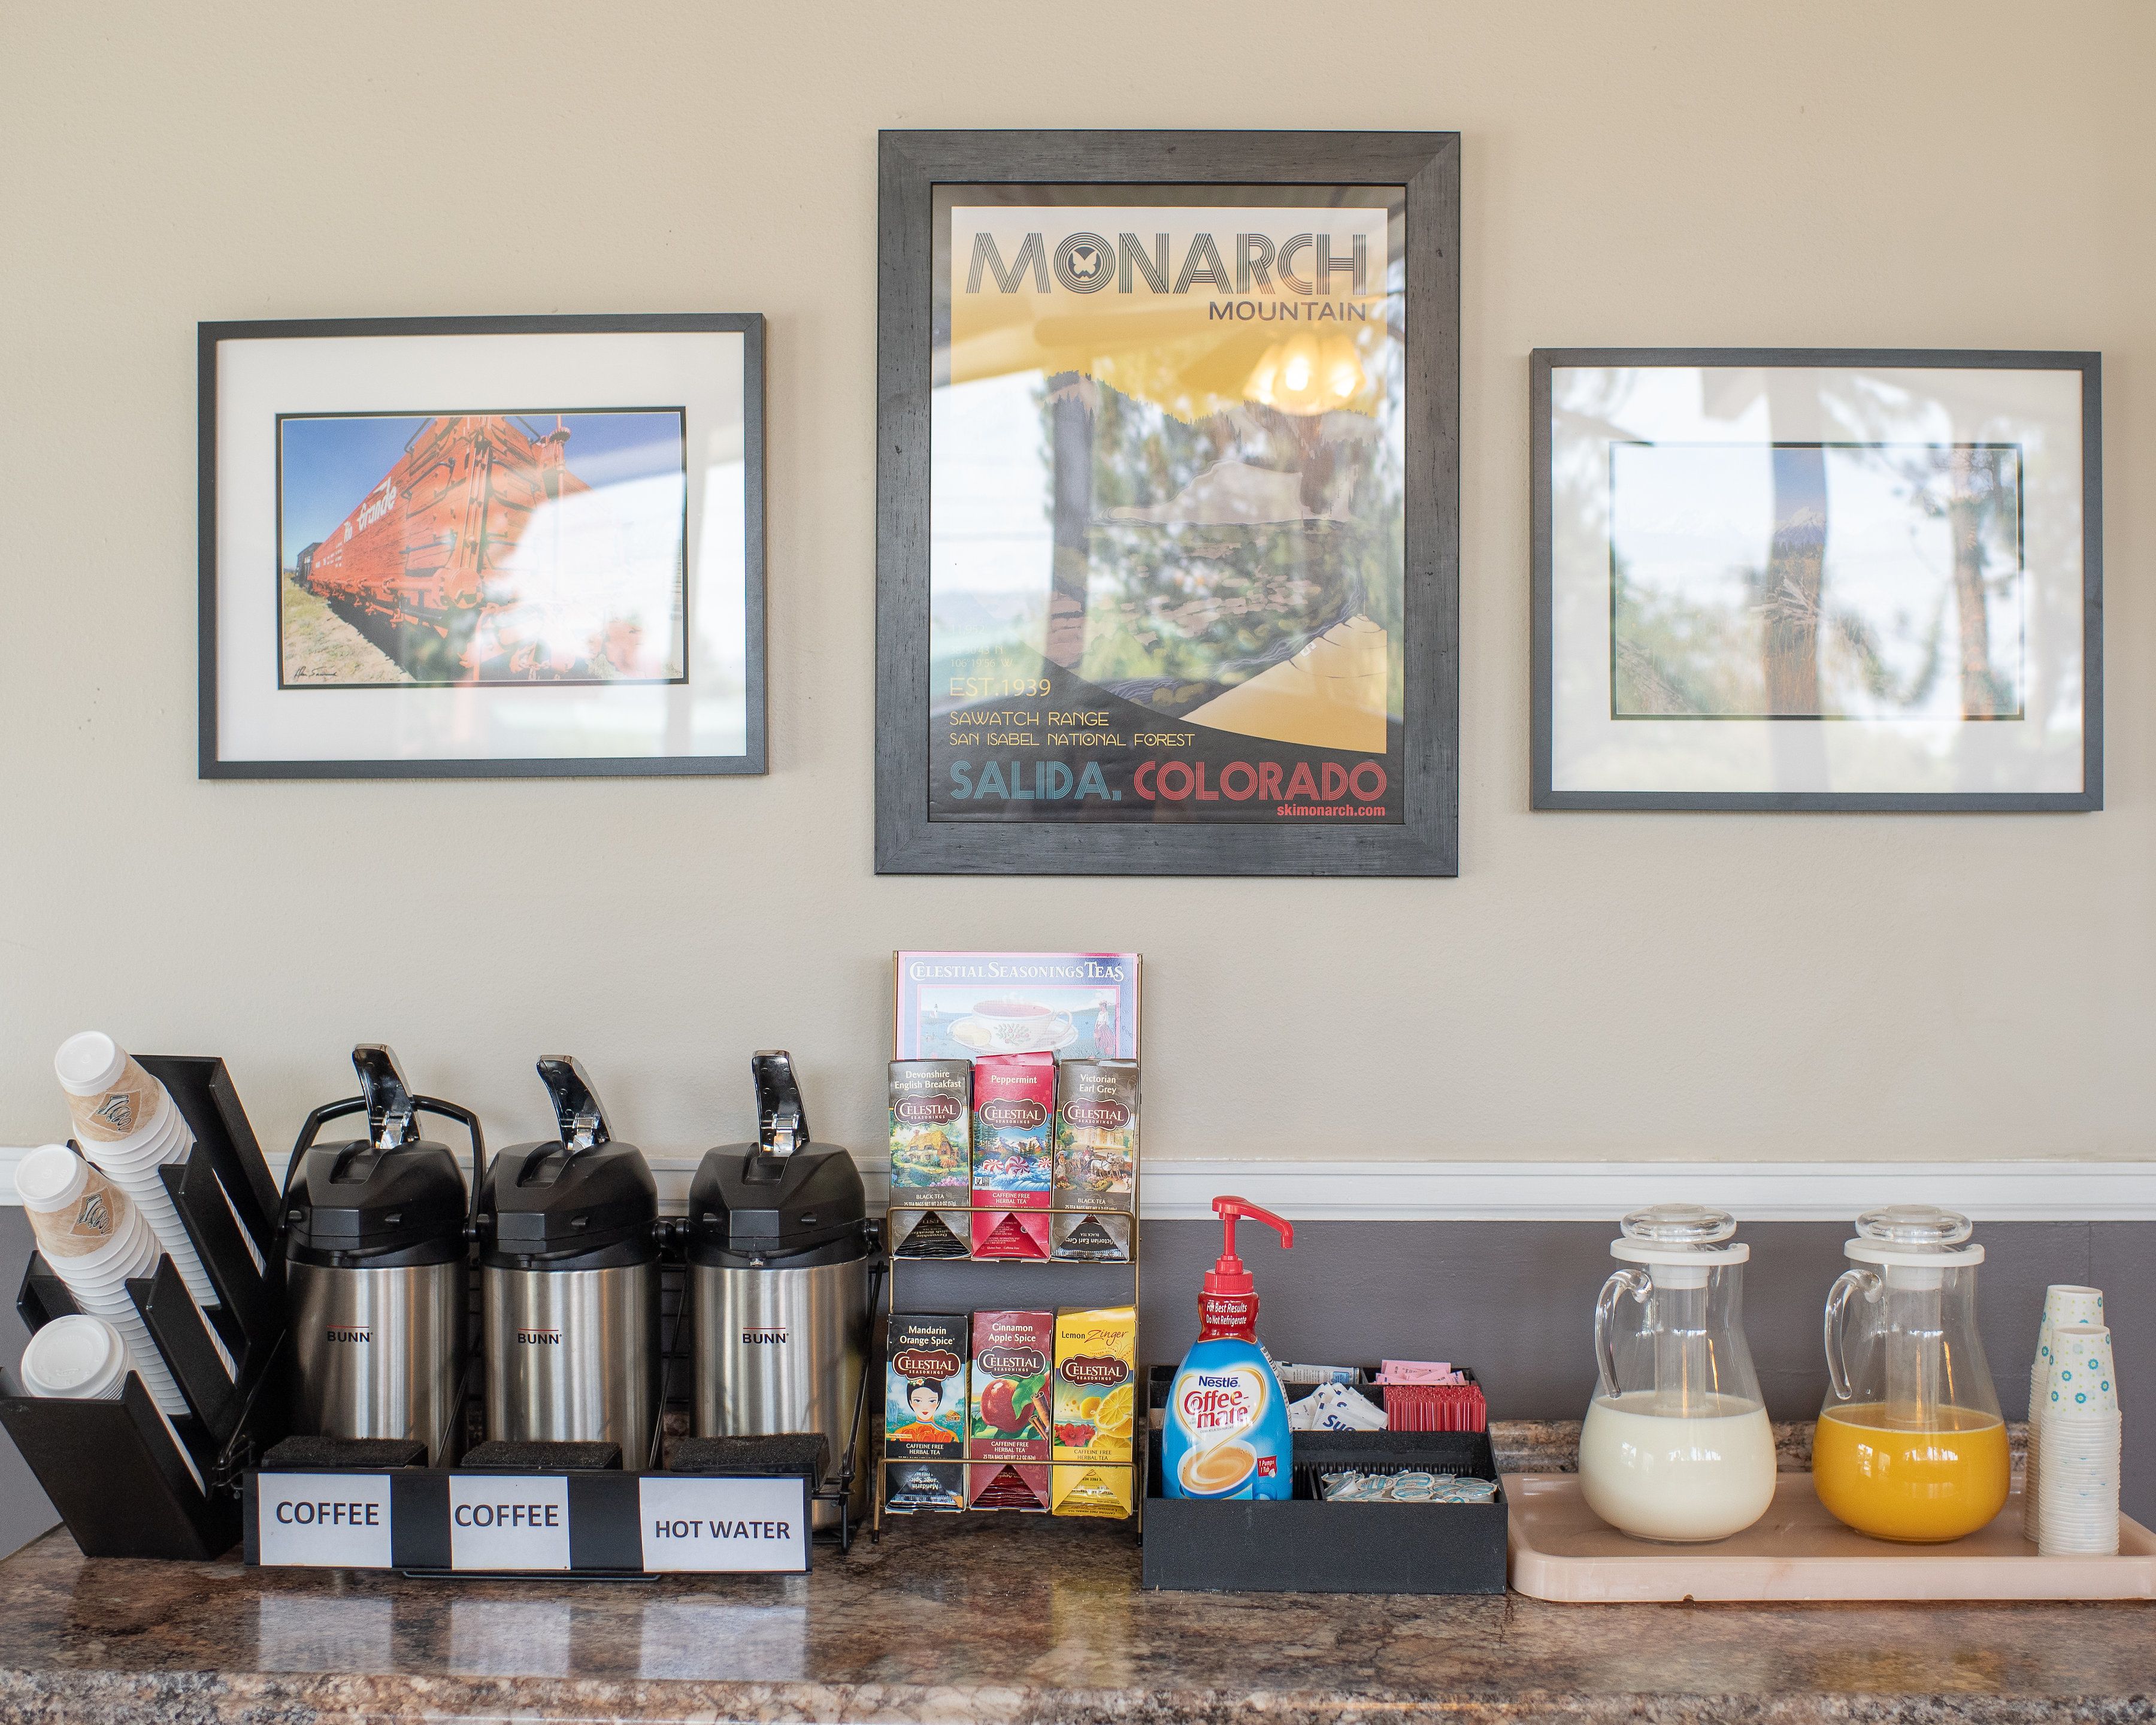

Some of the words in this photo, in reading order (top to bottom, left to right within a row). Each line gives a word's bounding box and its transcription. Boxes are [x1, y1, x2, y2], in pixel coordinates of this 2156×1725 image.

[966, 232, 1367, 295] MONARCH
[1209, 301, 1366, 321] MOUNTAIN
[1001, 658, 1013, 668] W
[949, 712, 1040, 726] SAWATCH
[1048, 712, 1110, 727] RANGE
[949, 733, 979, 746] SAN
[987, 733, 1040, 746] ISABEL
[1047, 733, 1127, 746] NATIONAL
[1134, 734, 1195, 747] FOREST
[950, 761, 1122, 801] SALIDA,
[1134, 761, 1387, 801] COLORADO
[1277, 804, 1386, 818] skimonarch.com
[910, 961, 987, 981] CELESTIAL
[988, 961, 1084, 979] SEASONINGS
[1084, 961, 1125, 982] TEAS
[906, 1070, 950, 1079] Devonshire
[991, 1075, 1037, 1085] Peppermint
[1080, 1073, 1116, 1084] Victorian
[895, 1081, 922, 1091] English
[925, 1079, 962, 1088] Breakfast
[1079, 1084, 1095, 1092] Earl
[1097, 1085, 1117, 1095] Grey
[900, 1102, 956, 1117] CELESTIAL
[985, 1106, 1041, 1121] CELESTIAL
[1067, 1105, 1124, 1121] CELESTIAL
[1215, 1302, 1227, 1313] Best
[1227, 1302, 1247, 1313] Results
[992, 1323, 1033, 1332] Cinnamon
[1206, 1314, 1212, 1323] Do
[1221, 1315, 1247, 1327] Refrigerate
[909, 1325, 947, 1334] Mandarin
[327, 1331, 371, 1343] BUNN
[517, 1332, 559, 1344] BUNN
[743, 1332, 786, 1344] BUNN
[900, 1335, 929, 1346] Orange
[988, 1333, 1013, 1343] Apple
[1014, 1333, 1036, 1343] Spice
[1061, 1330, 1086, 1339] Lemon
[1084, 1329, 1127, 1346] Zinger
[898, 1356, 955, 1371] CELESTIAL
[983, 1354, 1040, 1369] CELESTIAL
[1065, 1362, 1123, 1377] CELESTIAL
[1198, 1375, 1239, 1388] Nestlé
[276, 1500, 380, 1526] COFFEE
[454, 1503, 559, 1527] COFFEE
[655, 1520, 703, 1538] HOT
[709, 1520, 791, 1539] WATER
